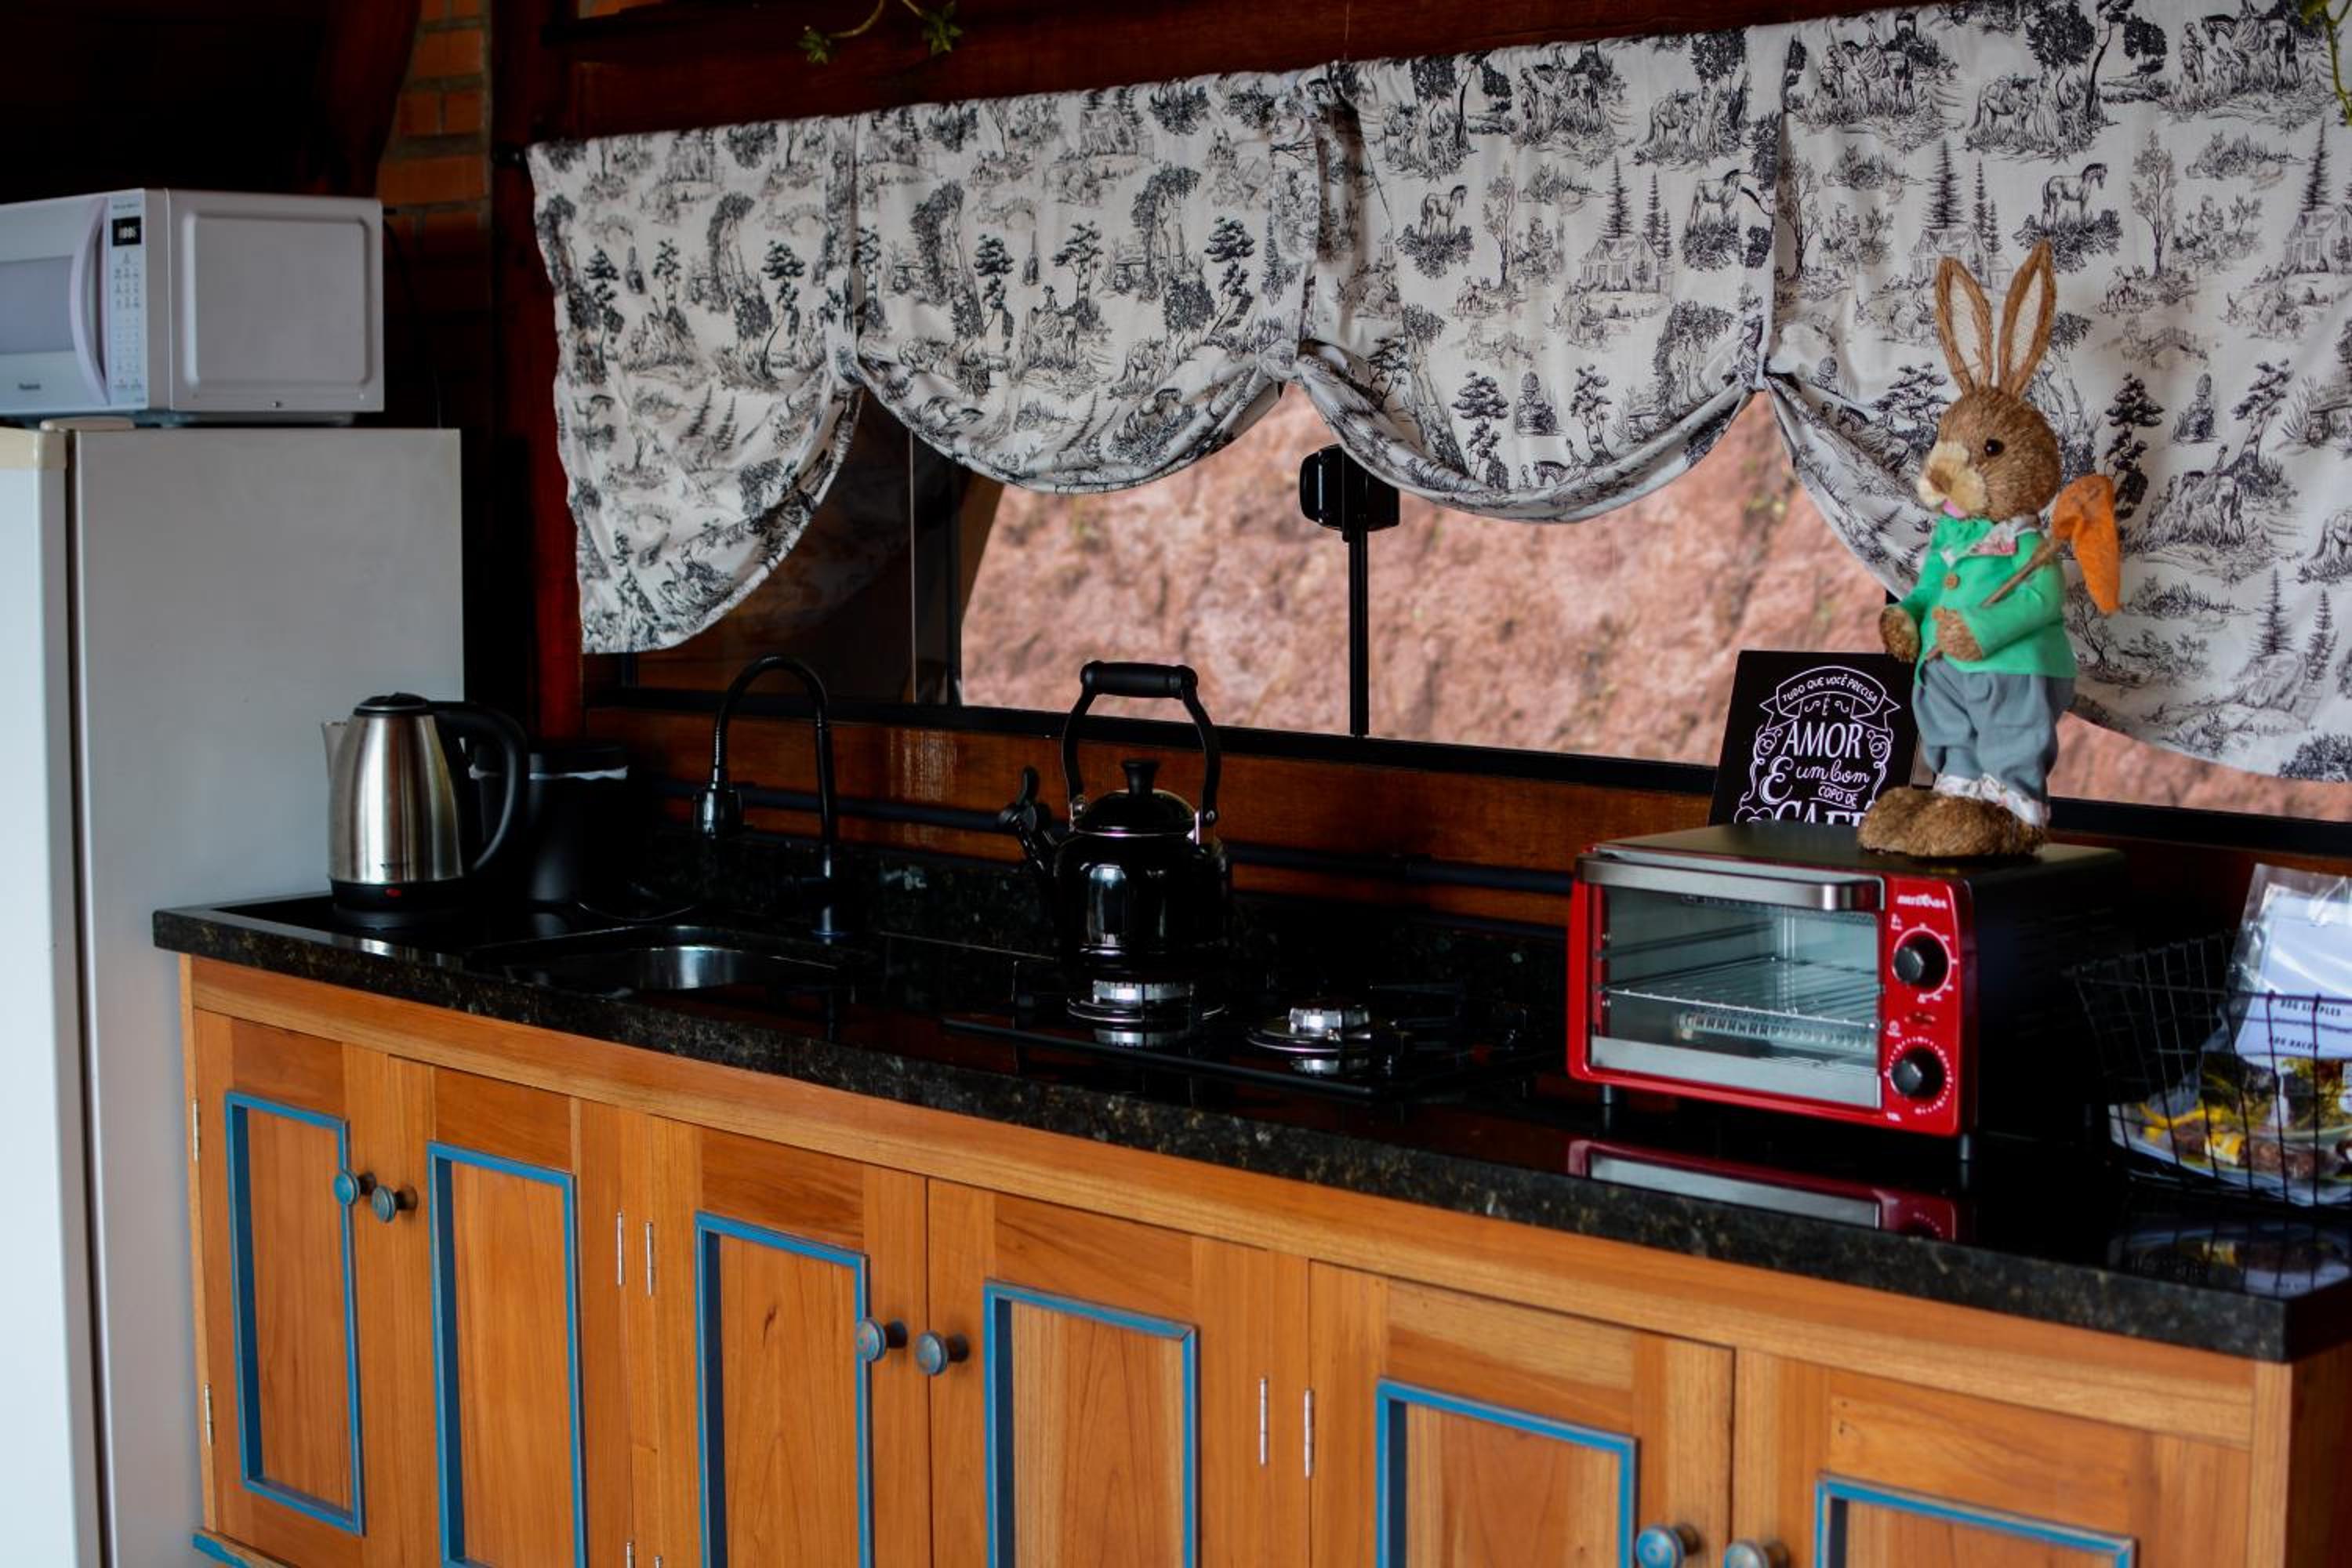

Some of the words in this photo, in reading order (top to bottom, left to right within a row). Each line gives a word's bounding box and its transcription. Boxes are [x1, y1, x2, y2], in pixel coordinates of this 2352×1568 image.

[1782, 684, 1806, 702] TUDO
[1806, 677, 1824, 689] QUE
[1826, 673, 1848, 686] VOCÊ
[1847, 678, 1878, 704] PRECISA
[1780, 720, 1864, 759] AMOR
[1759, 755, 1795, 805] E
[1796, 766, 1829, 779] um
[1831, 758, 1871, 782] bom
[1818, 786, 1844, 801] COPO
[1845, 793, 1858, 807] DE
[2302, 1003, 2341, 1017] SIPLES
